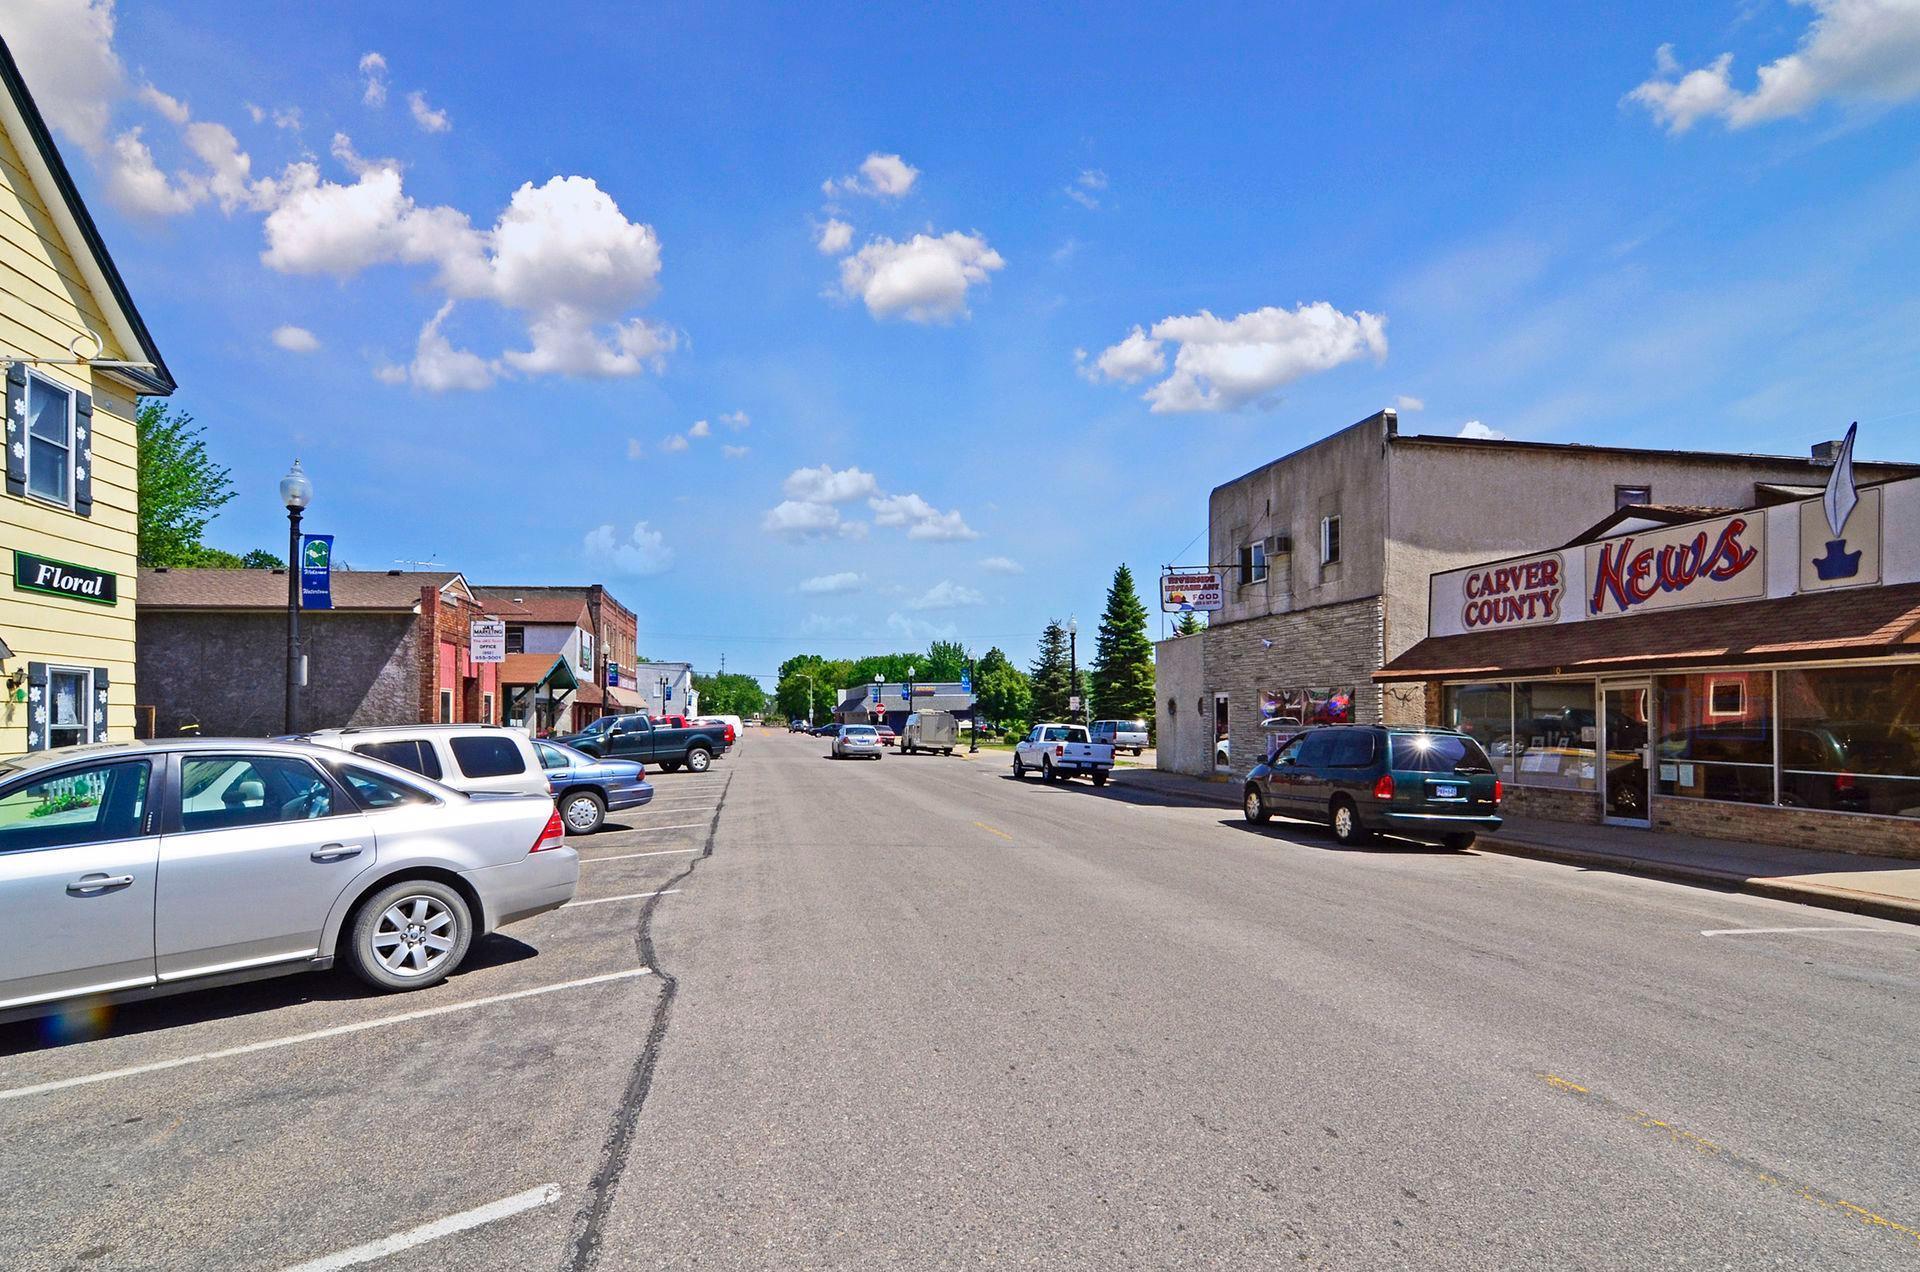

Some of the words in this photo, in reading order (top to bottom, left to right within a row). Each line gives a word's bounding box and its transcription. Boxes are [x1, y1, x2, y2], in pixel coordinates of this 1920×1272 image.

[34, 563, 103, 596] Floral
[1466, 559, 1559, 600] CARVER
[1464, 588, 1560, 628] COUNTY
